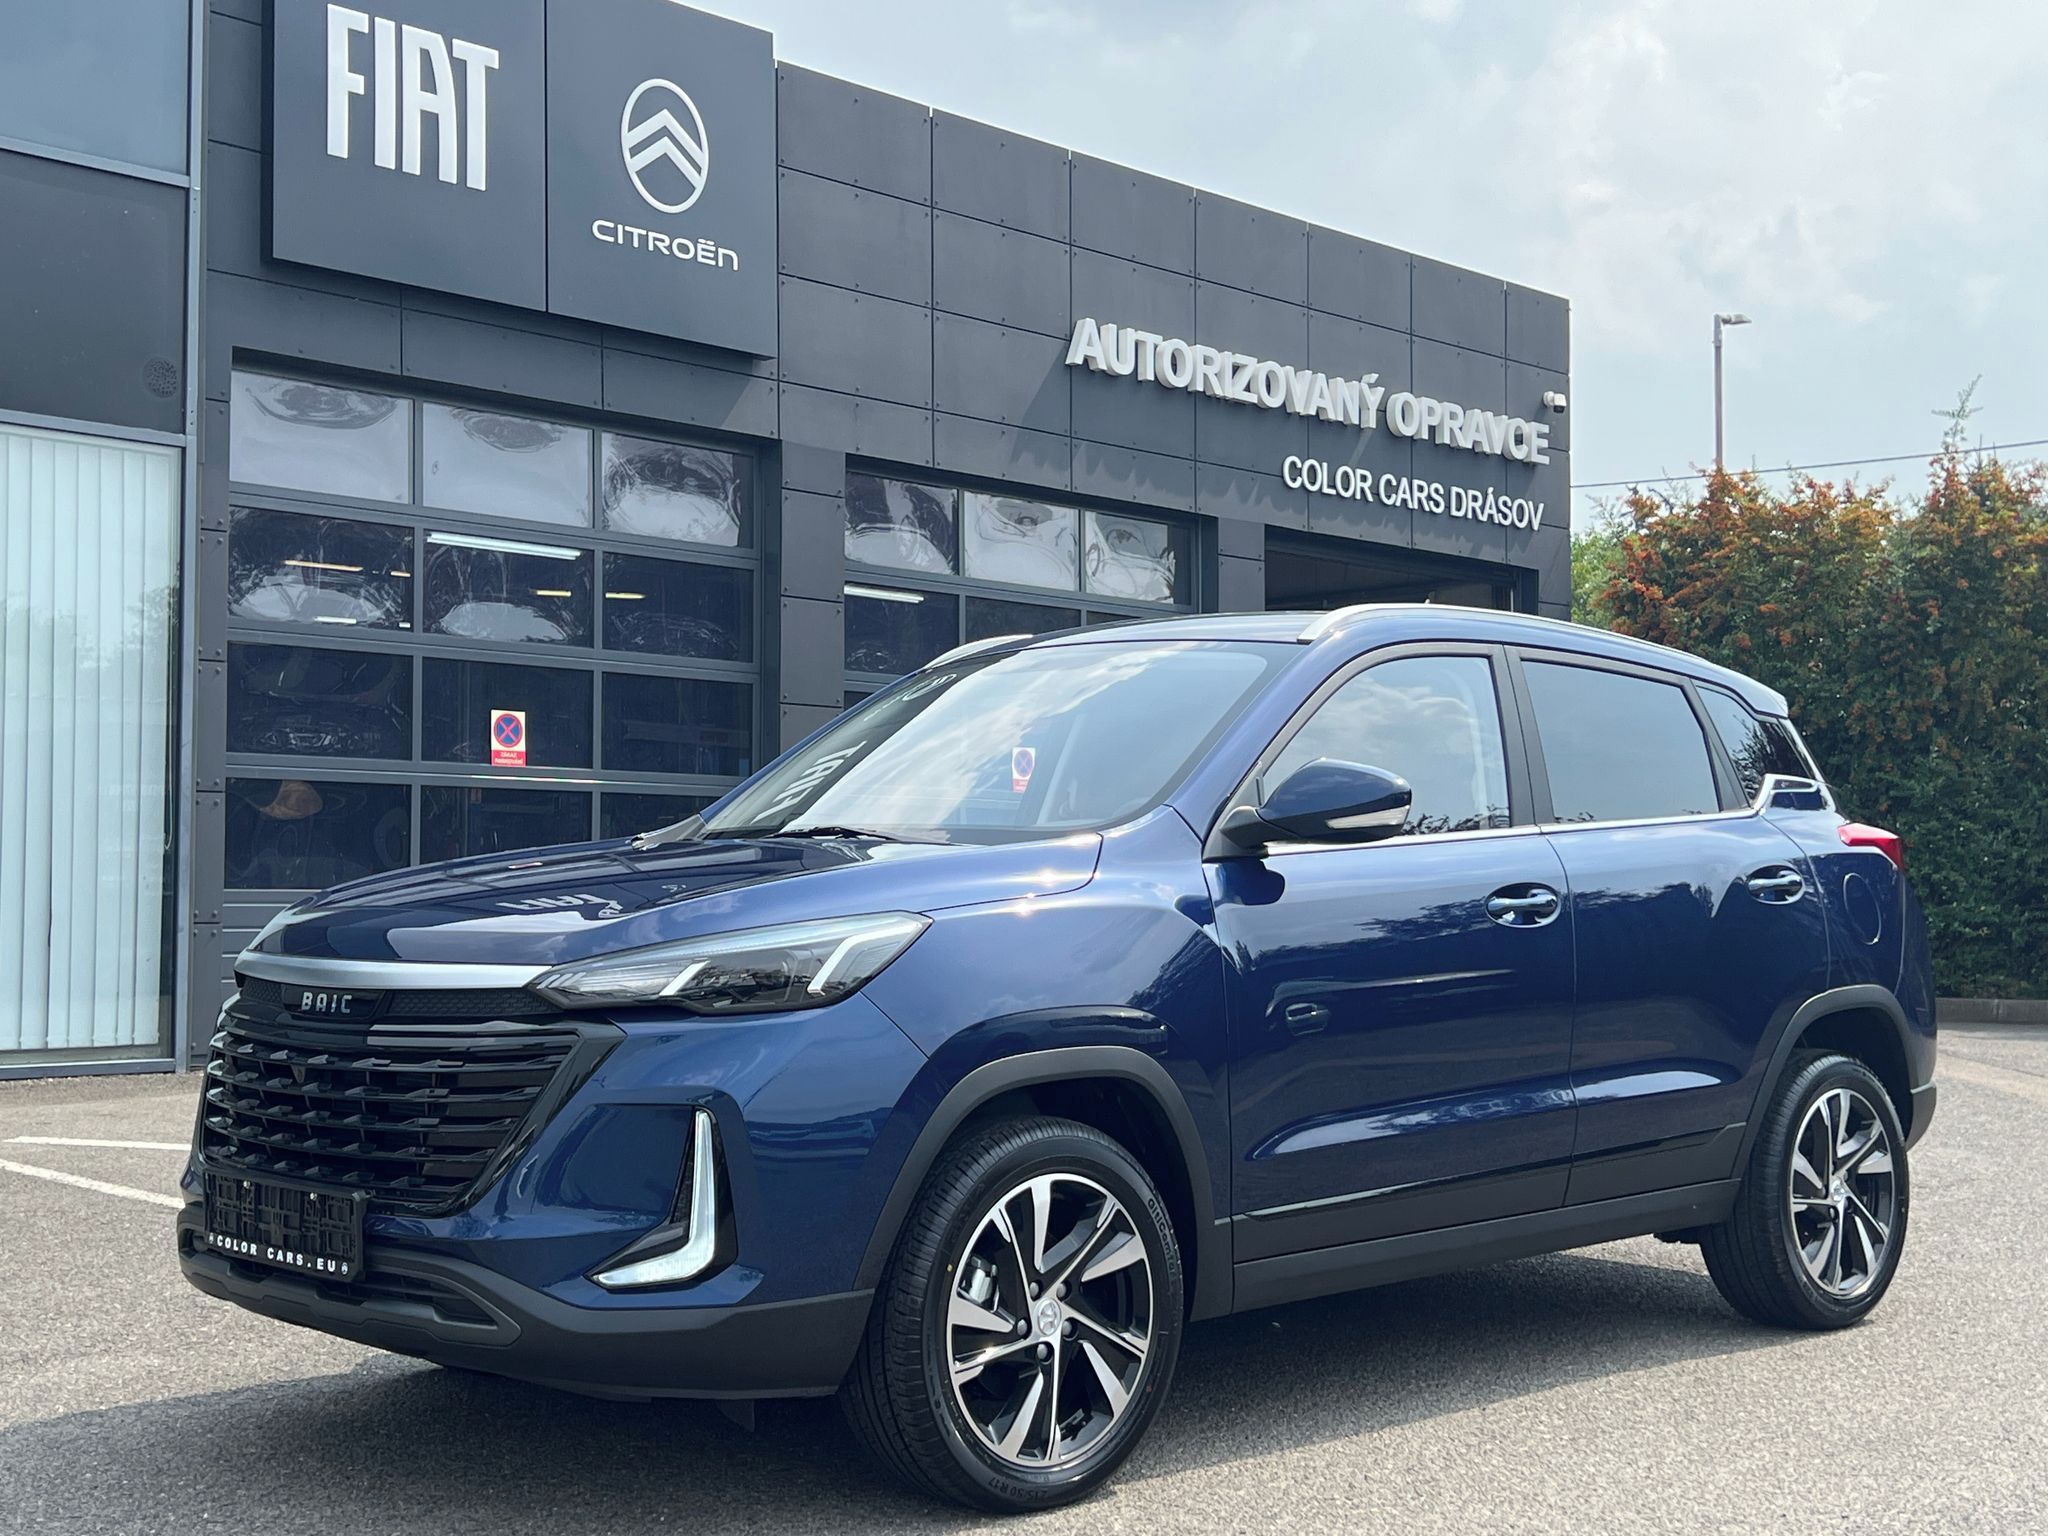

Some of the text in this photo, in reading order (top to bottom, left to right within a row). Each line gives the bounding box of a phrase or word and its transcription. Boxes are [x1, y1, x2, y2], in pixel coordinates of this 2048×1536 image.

[327, 3, 500, 192] FIAT
[591, 219, 740, 272] CITROËN
[1065, 317, 1550, 465] AUTORIZOVANÝ OPRAVCE
[1282, 455, 1545, 531] COLOR CARS DRÁSOV
[301, 991, 352, 1014] BAIC
[217, 1235, 336, 1273] COLOR CARS.EU
